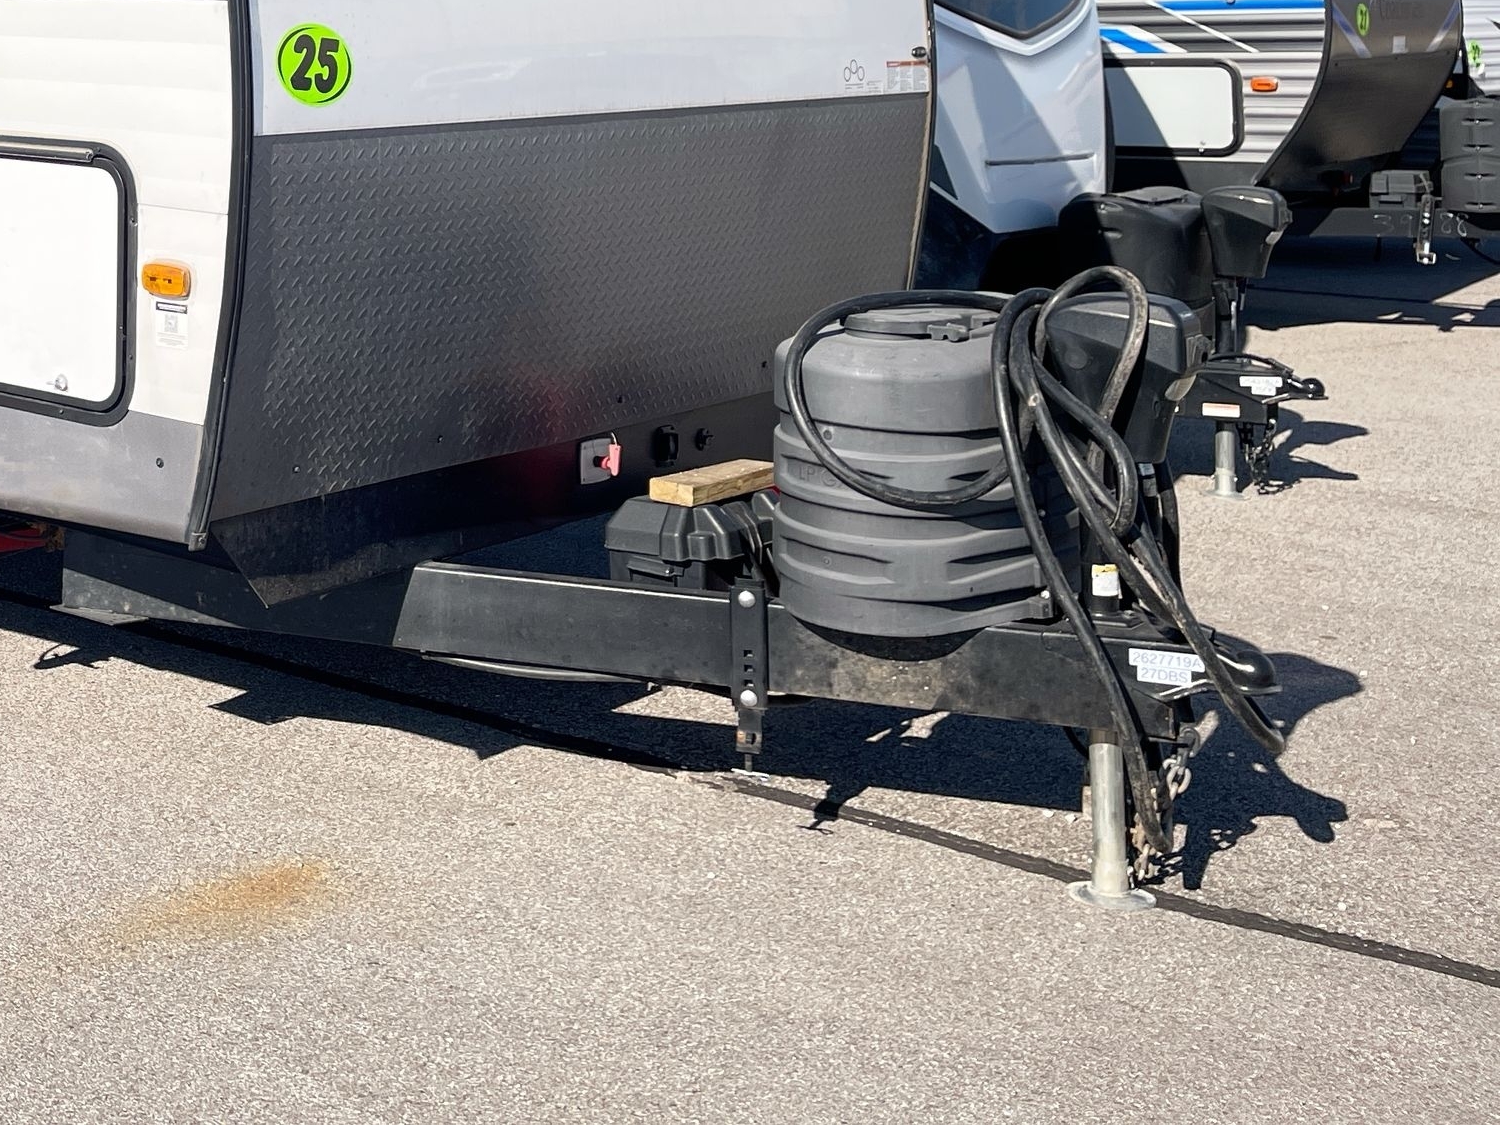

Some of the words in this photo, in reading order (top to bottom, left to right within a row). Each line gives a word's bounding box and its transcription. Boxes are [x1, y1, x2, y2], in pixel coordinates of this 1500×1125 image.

[289, 33, 340, 95] 25
[1132, 651, 1202, 668] 2627719A
[1141, 667, 1189, 684] 27DBS
